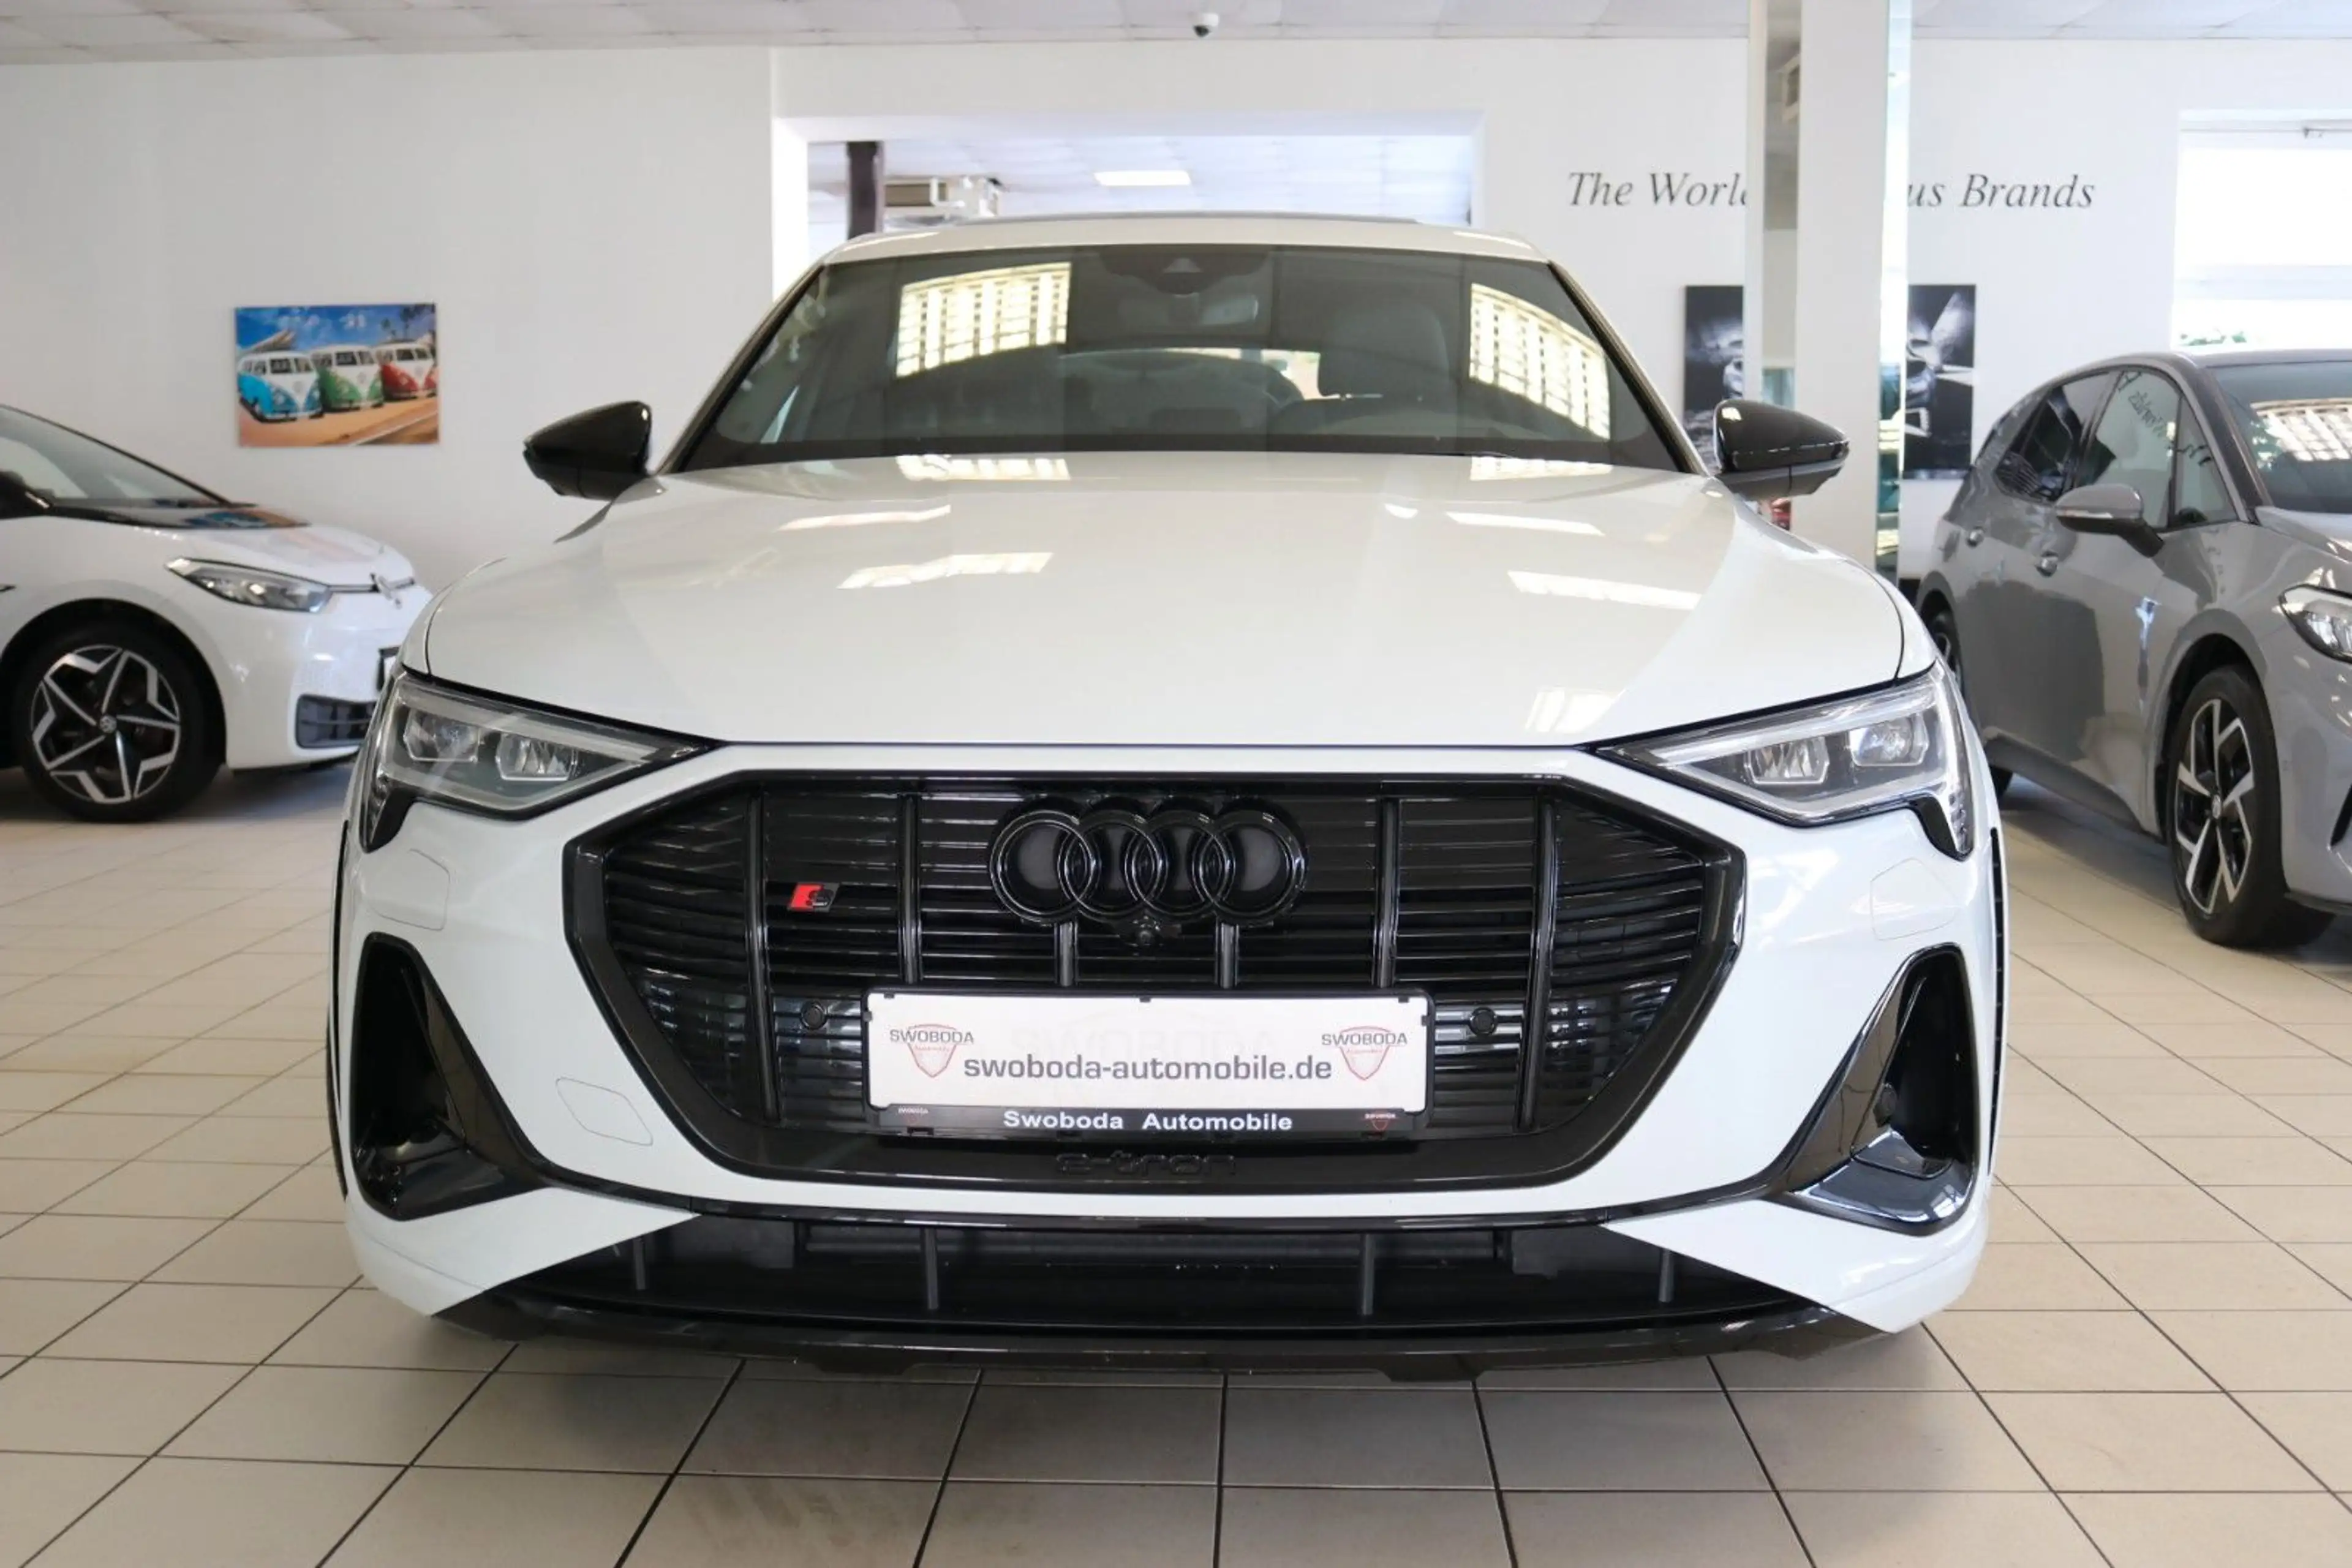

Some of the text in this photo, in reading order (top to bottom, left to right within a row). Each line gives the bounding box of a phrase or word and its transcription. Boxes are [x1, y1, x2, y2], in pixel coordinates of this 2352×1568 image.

[1569, 171, 1633, 206] The
[1960, 173, 2094, 208] Brands
[889, 1028, 974, 1044] SWOBODA
[1321, 1032, 1408, 1046] SWOBODA
[963, 1053, 1332, 1080] swoboda-automobile.de
[1003, 1110, 1294, 1131] Swoboda Automobile
